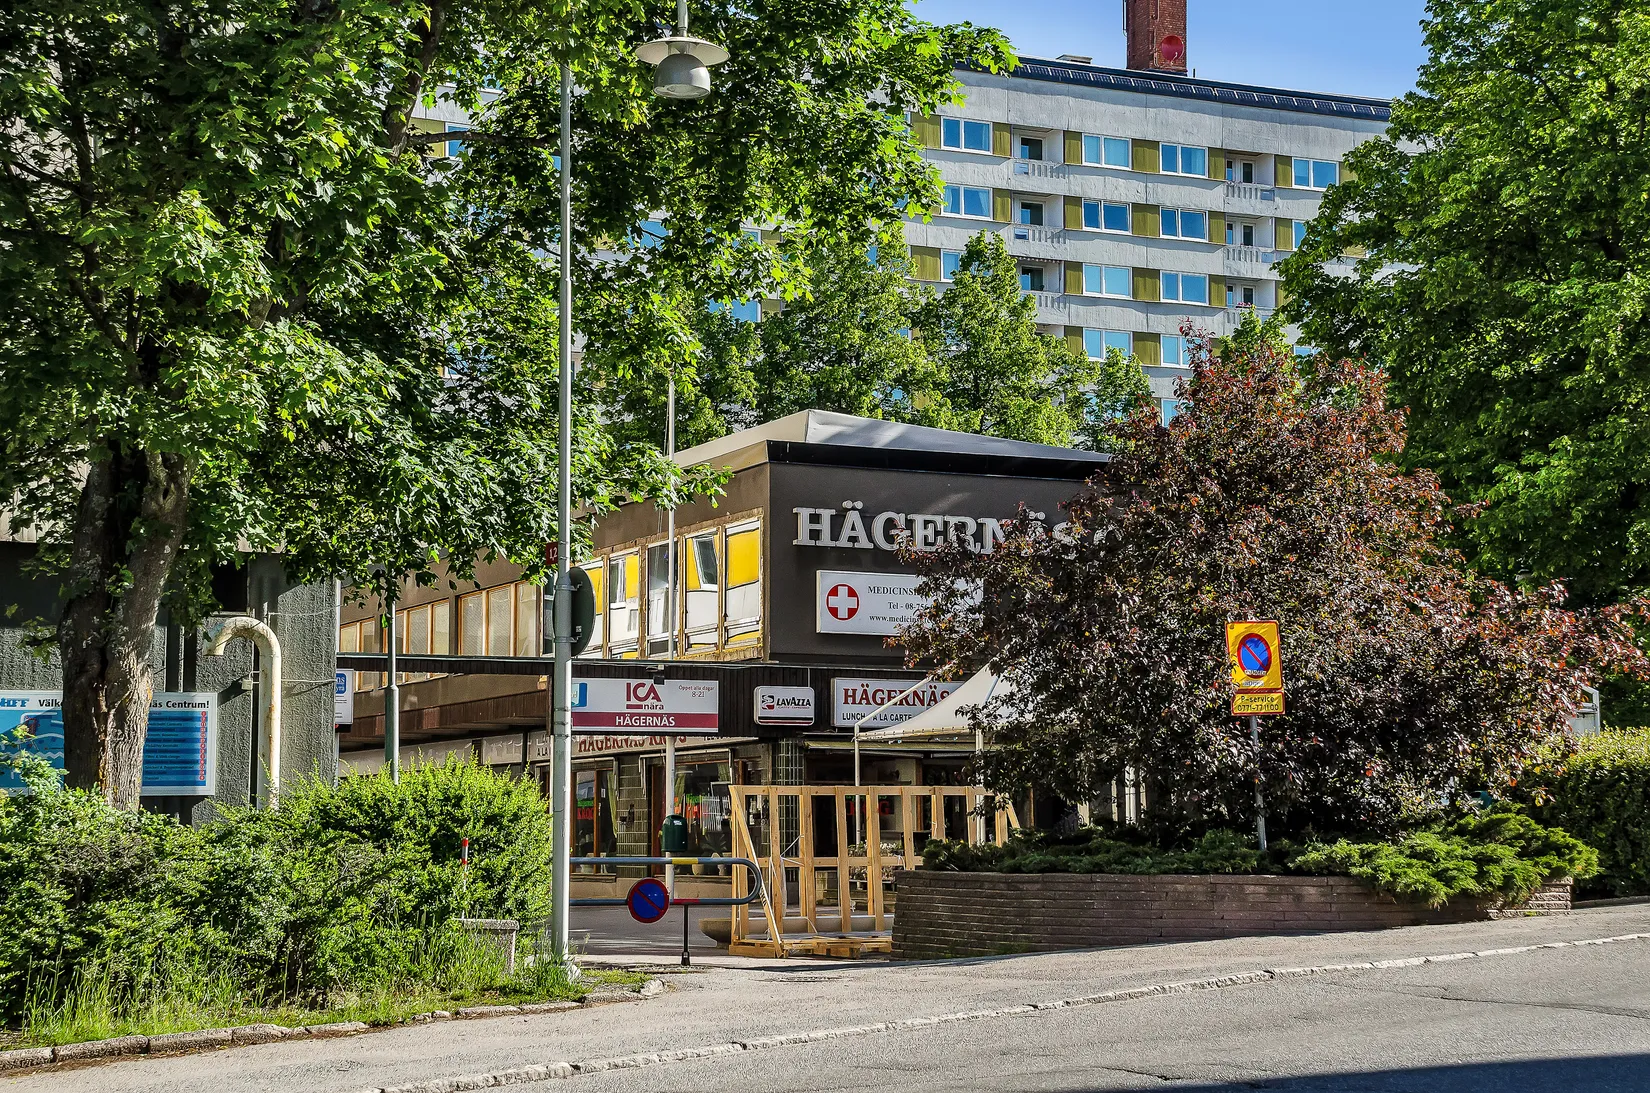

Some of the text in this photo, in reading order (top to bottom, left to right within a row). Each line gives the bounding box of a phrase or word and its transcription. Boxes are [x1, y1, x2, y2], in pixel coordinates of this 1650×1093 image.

[626, 682, 662, 702] ICA
[843, 683, 950, 707] HÄGERNÄS
[166, 700, 210, 708] Centrum!
[643, 703, 664, 711] nära
[615, 714, 676, 727] HÄGERNÄS
[842, 712, 866, 721] LUNCH
